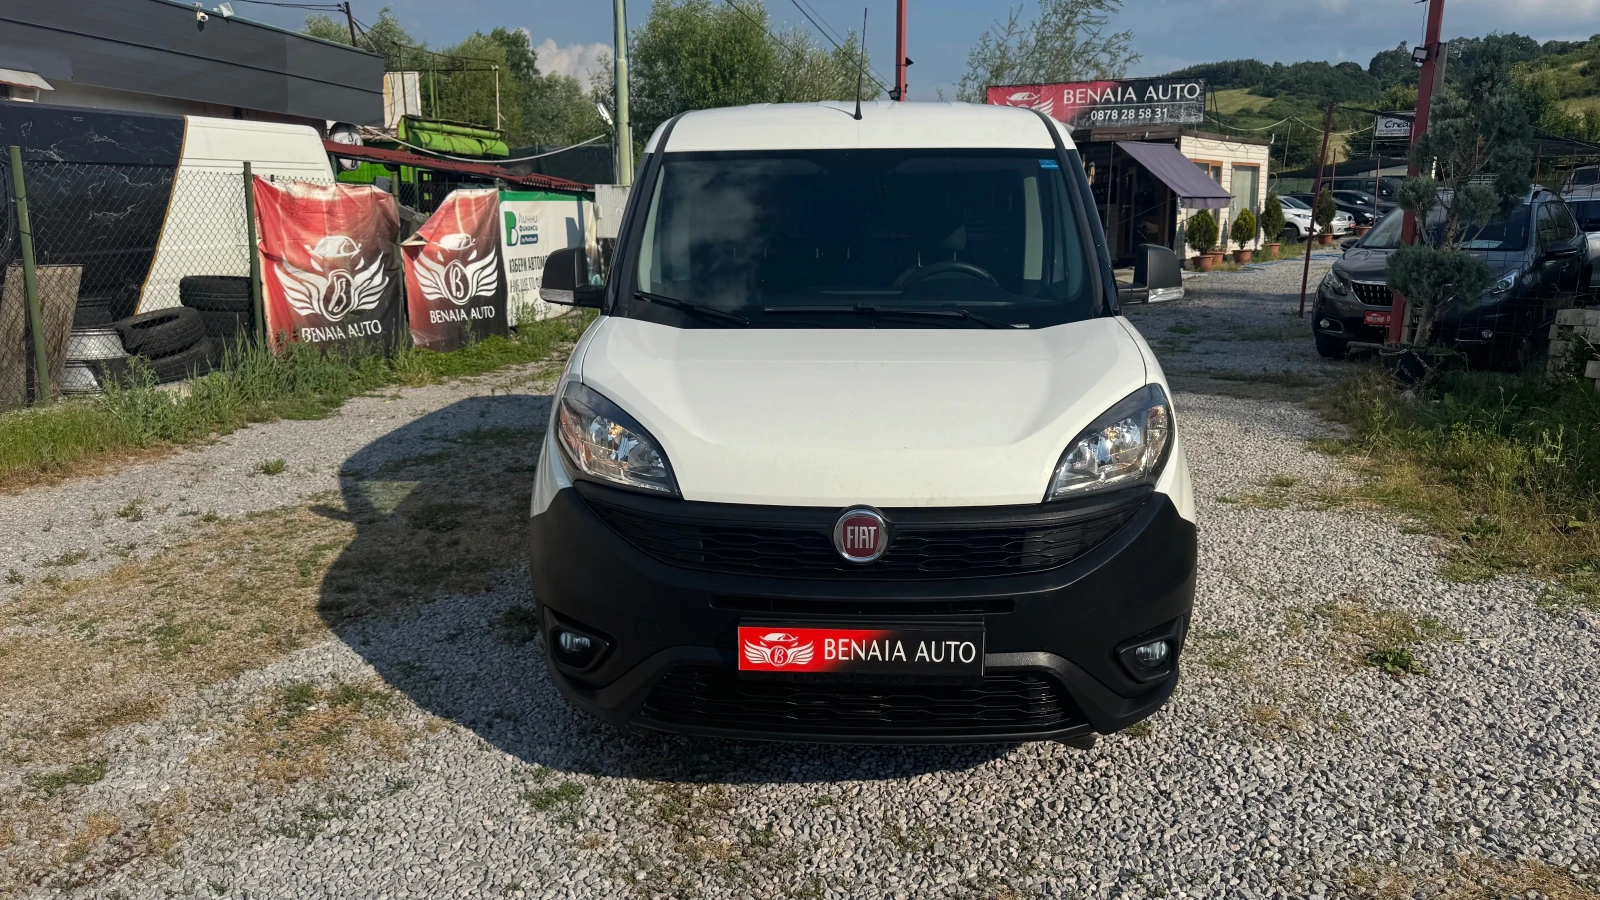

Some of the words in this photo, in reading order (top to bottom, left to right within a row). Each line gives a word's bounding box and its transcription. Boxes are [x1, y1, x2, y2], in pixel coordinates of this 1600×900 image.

[1063, 86, 1137, 104] BENAIA
[1144, 83, 1200, 101] AUTO
[1090, 109, 1118, 120] 0878
[1121, 109, 1135, 120] 28
[1138, 108, 1152, 119] 58
[1154, 107, 1168, 118] 31
[429, 308, 468, 324] BENAIA
[470, 305, 495, 320] AUTO
[301, 325, 347, 343] BENAIA
[348, 319, 382, 338] AUTO
[846, 525, 877, 549] FIAT
[823, 638, 907, 662] BENAIA
[914, 640, 977, 663] AUTO
